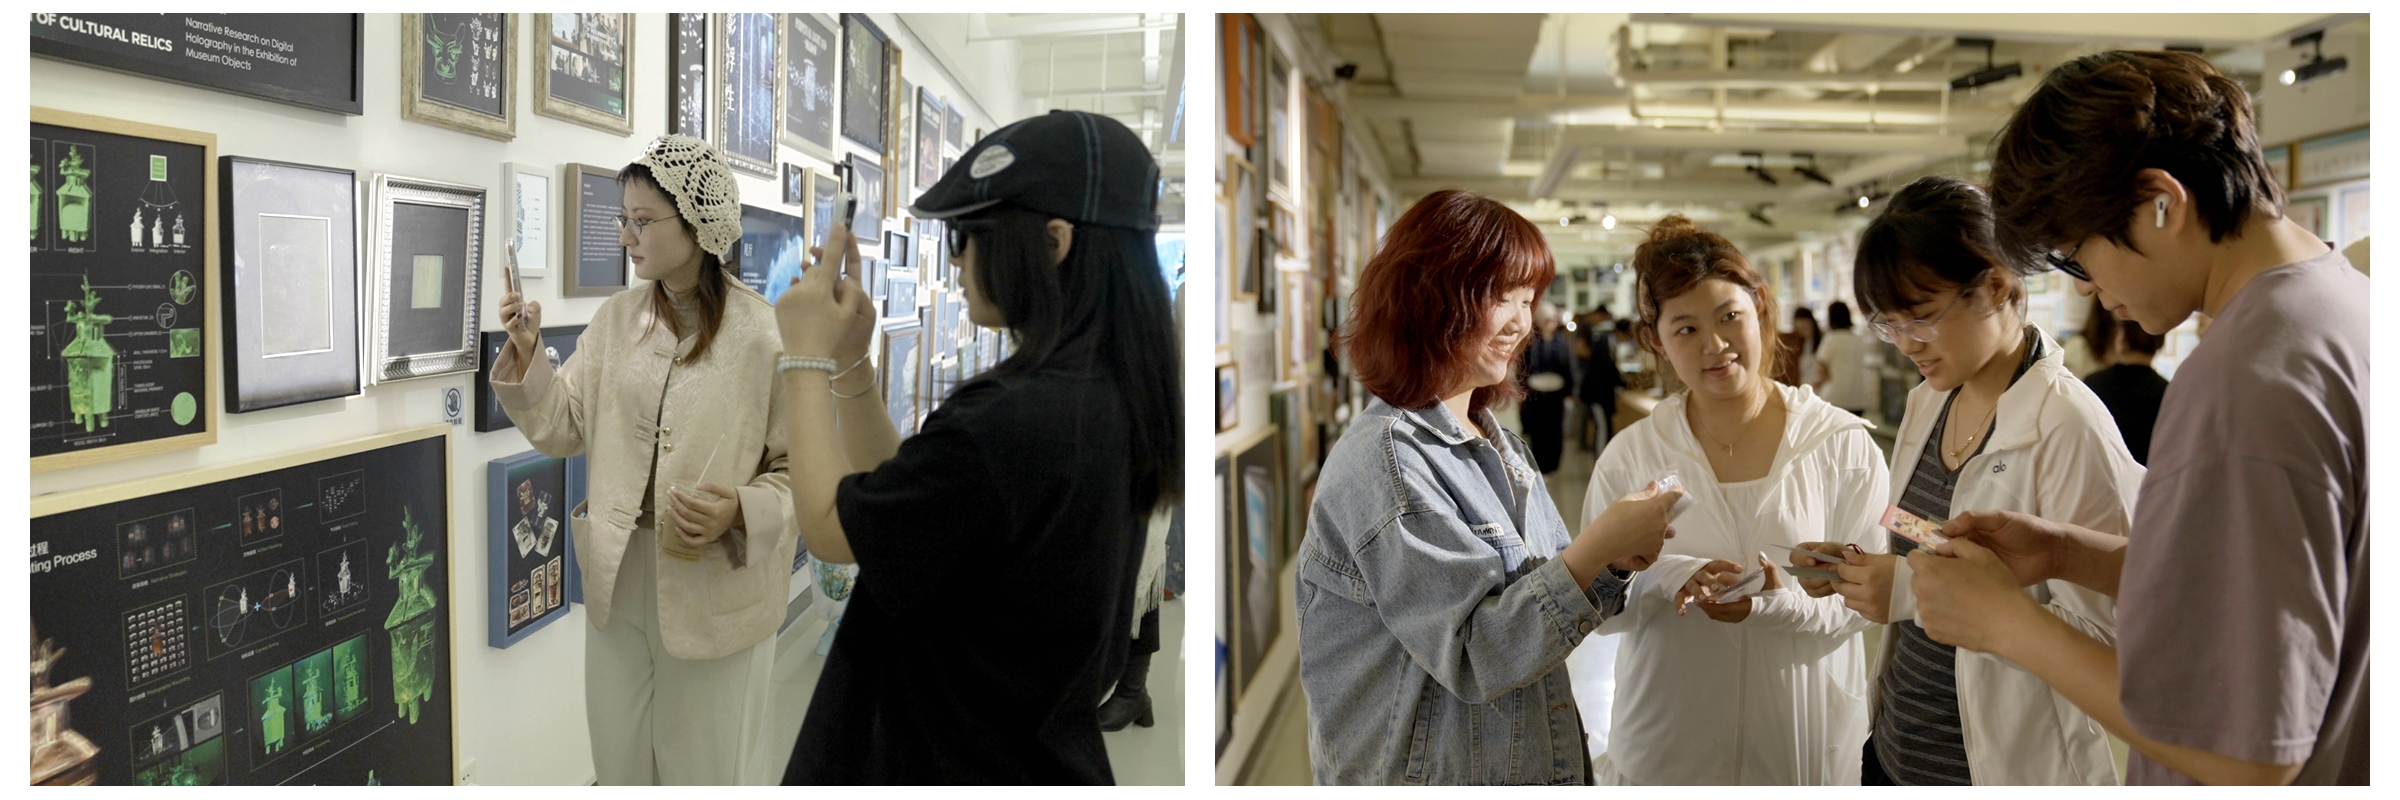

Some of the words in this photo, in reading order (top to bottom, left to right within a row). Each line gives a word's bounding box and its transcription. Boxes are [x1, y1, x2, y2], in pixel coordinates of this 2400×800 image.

[36, 13, 57, 26] OF
[59, 15, 129, 43] CULTURAL
[131, 31, 173, 52] RELICS
[185, 17, 223, 35] Narrative
[224, 26, 260, 44] Research
[260, 37, 271, 47] on
[271, 38, 294, 53] Digital
[185, 31, 233, 54] Holography
[233, 42, 241, 54] in
[241, 44, 255, 58] the
[255, 48, 289, 65] Exhibition
[289, 57, 298, 67] of
[185, 47, 221, 64] Museum
[221, 54, 252, 71] Objects
[30, 560, 51, 573] ting
[53, 549, 98, 568] Process
